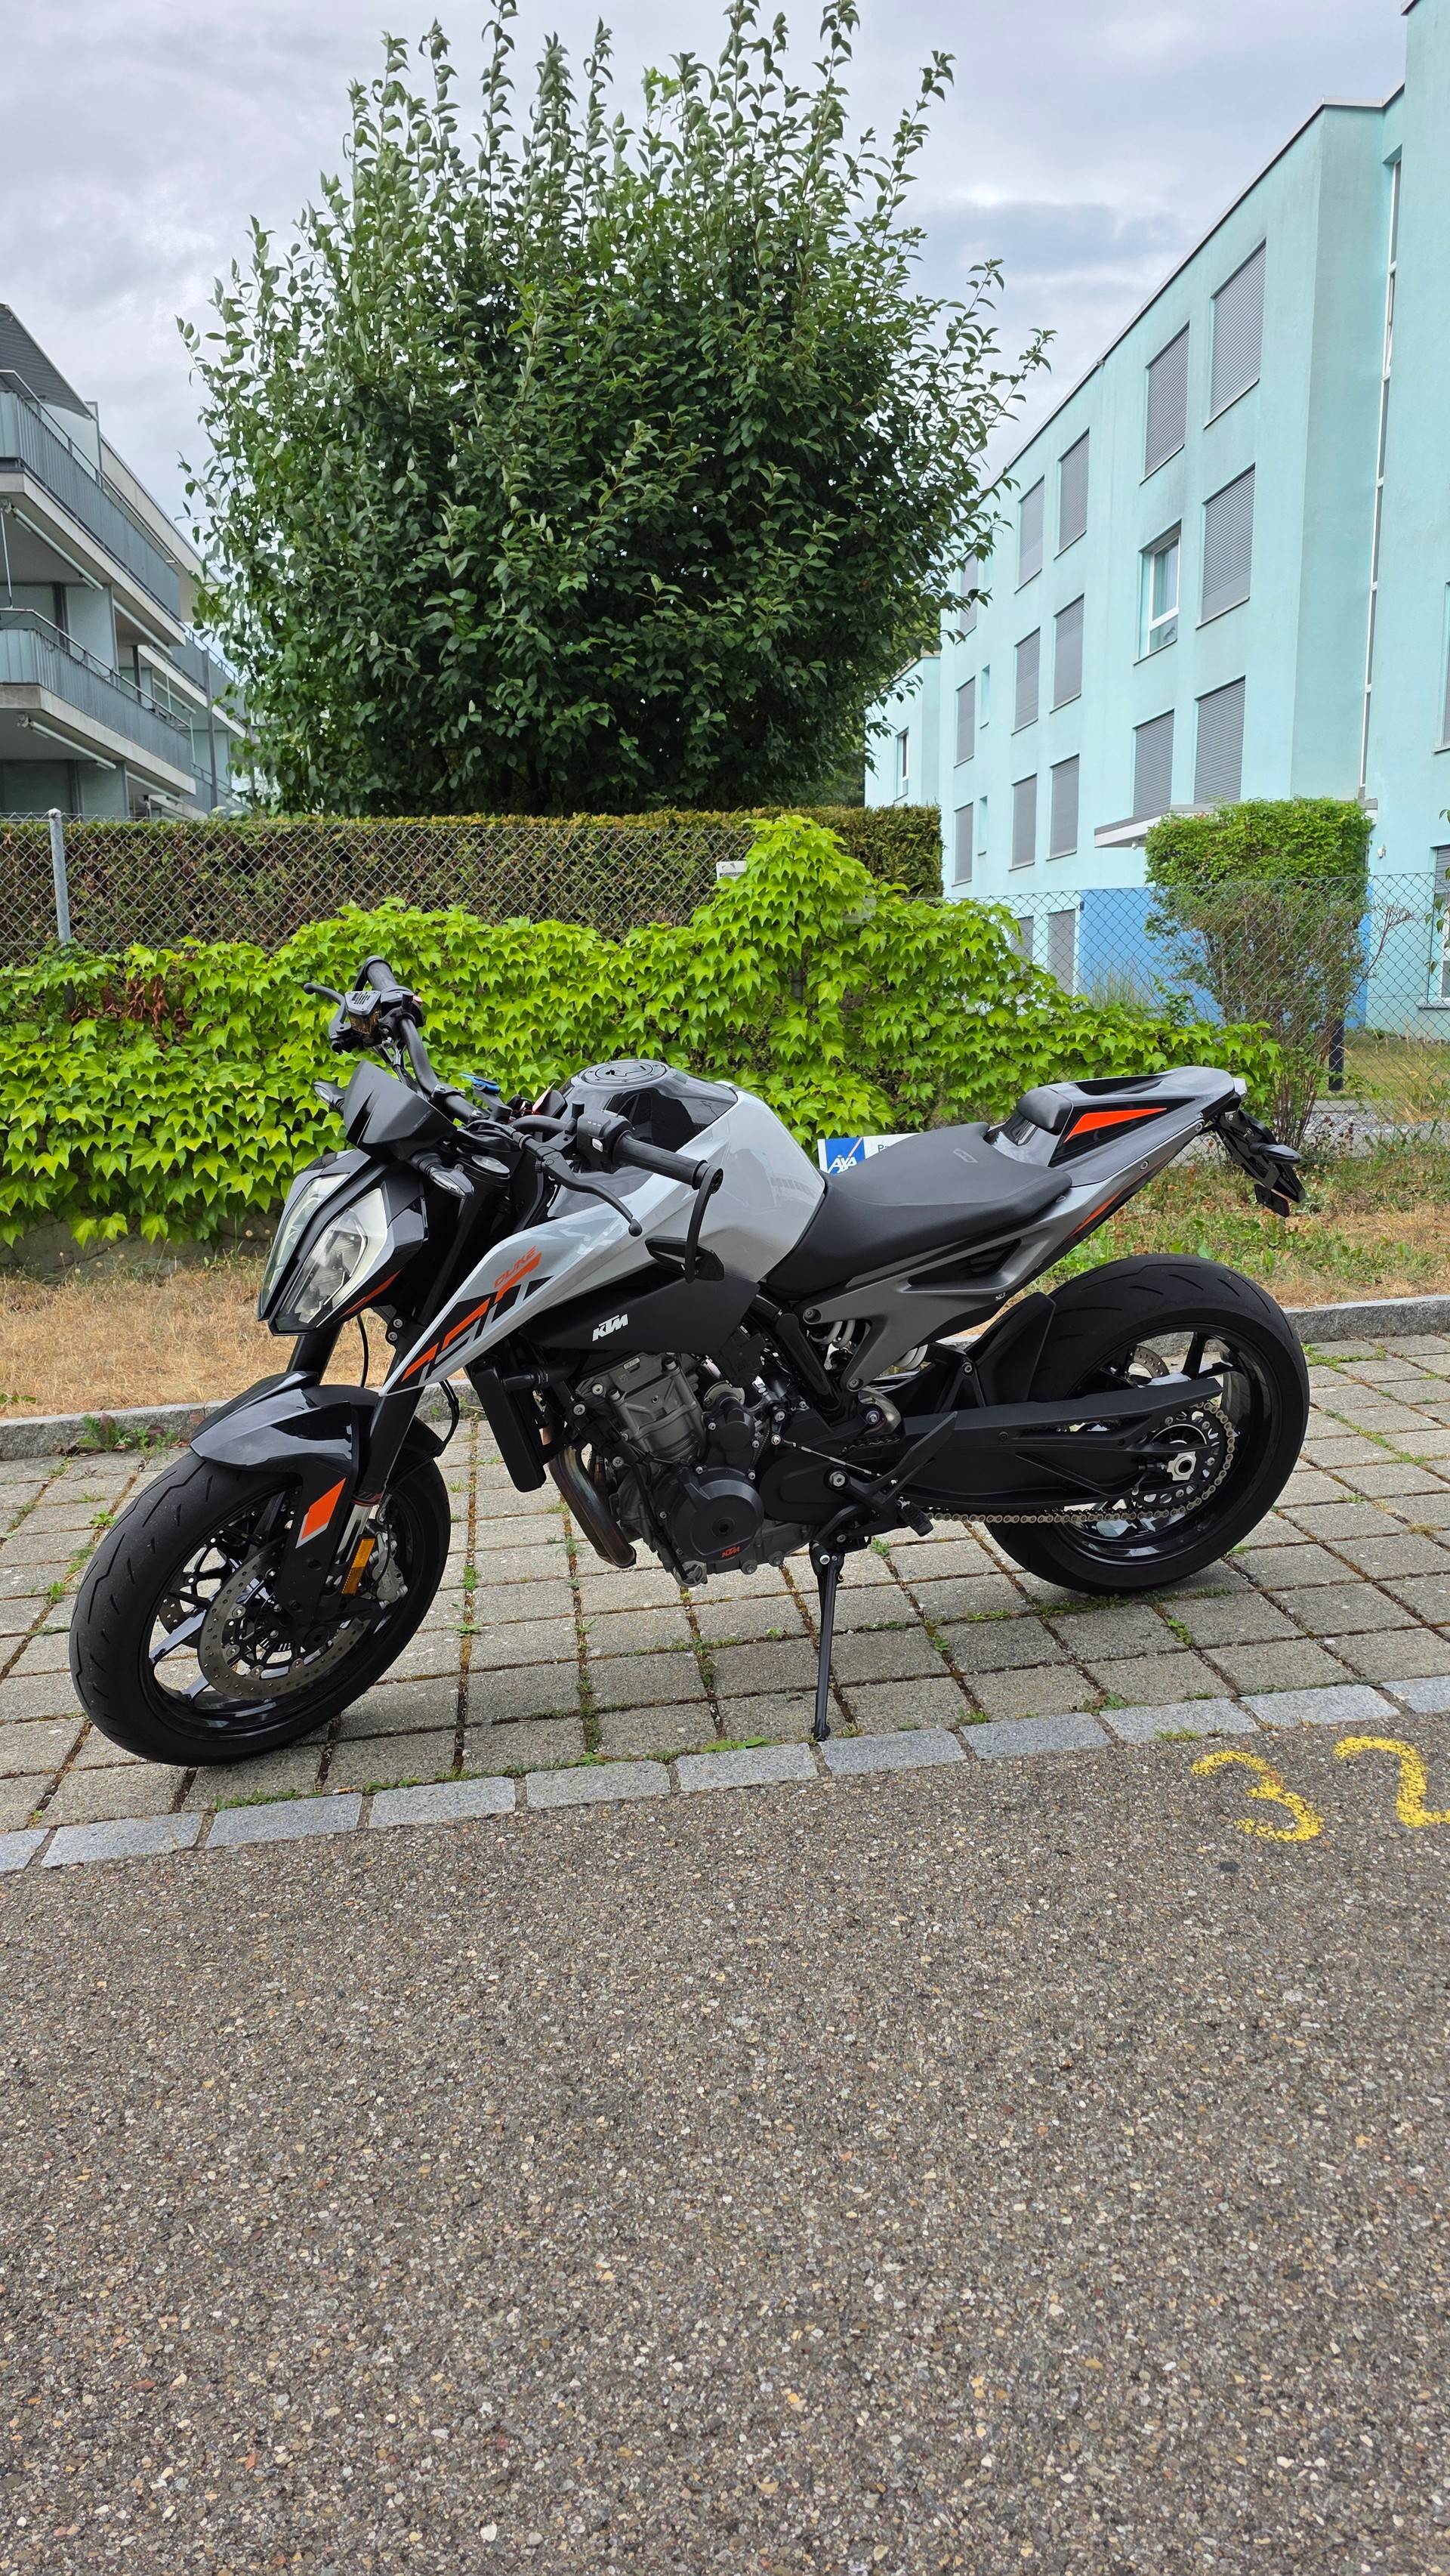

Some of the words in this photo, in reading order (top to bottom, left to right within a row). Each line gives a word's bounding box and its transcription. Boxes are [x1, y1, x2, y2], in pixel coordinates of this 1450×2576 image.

[828, 1156, 857, 1174] AXA
[493, 1245, 537, 1288] DUKE
[591, 1313, 628, 1342] KTM
[721, 1546, 741, 1558] KTM
